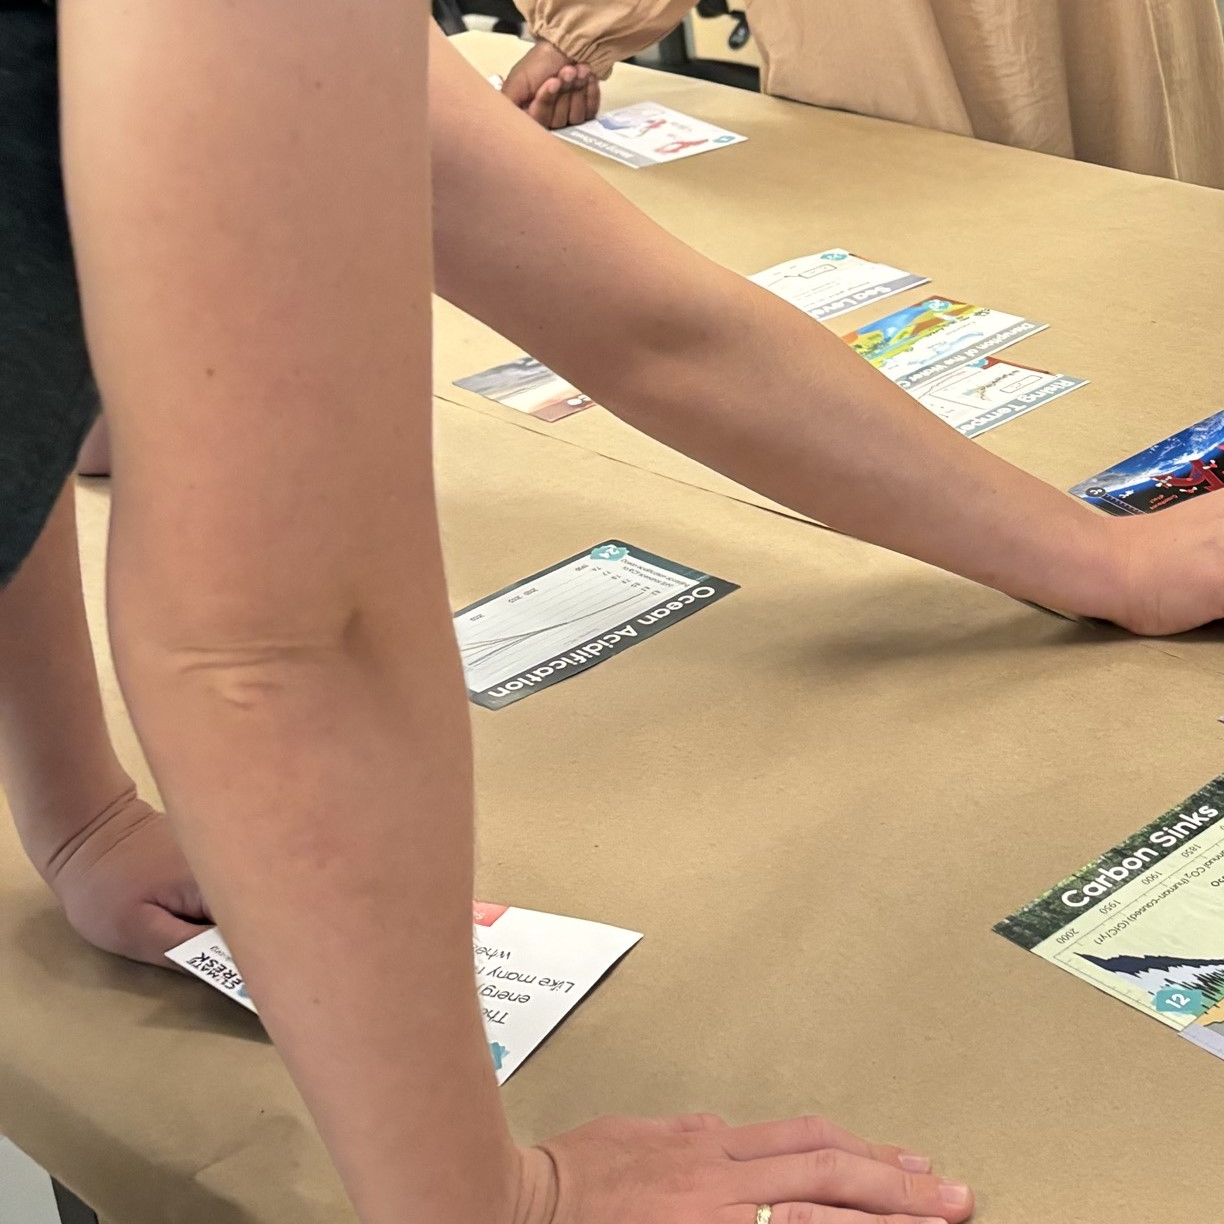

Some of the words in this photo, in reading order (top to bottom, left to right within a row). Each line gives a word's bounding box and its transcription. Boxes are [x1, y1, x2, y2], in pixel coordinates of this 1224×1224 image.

[1014, 378, 1075, 403] Rising
[636, 585, 715, 625] Ocean
[486, 624, 637, 702] Acidification
[1061, 846, 1159, 907] Carbon
[1149, 804, 1219, 847] Sinks
[1180, 843, 1201, 858] 1850
[1140, 870, 1162, 885] 1900
[1098, 899, 1121, 914] 1950
[1125, 877, 1189, 922] (human-caused)
[1054, 927, 1079, 944] 2000
[488, 966, 537, 984] many
[539, 977, 574, 993] Like
[1165, 992, 1191, 1008] 12
